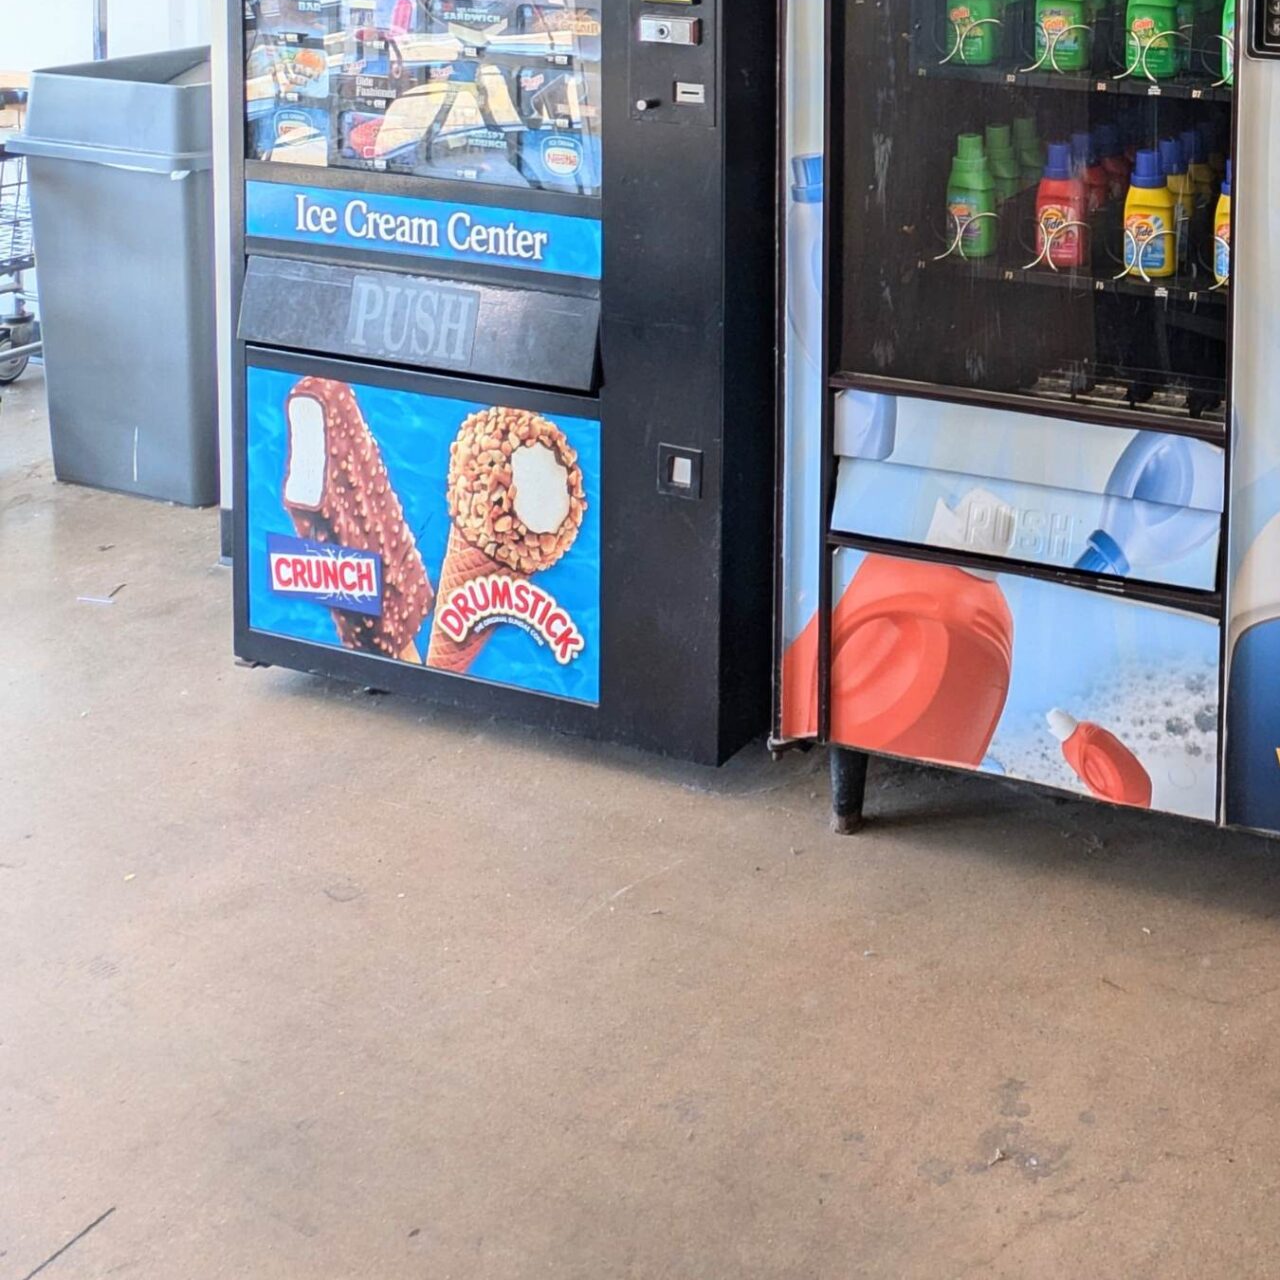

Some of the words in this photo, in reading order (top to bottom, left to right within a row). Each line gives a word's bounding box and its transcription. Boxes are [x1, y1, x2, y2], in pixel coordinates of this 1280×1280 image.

[443, 11, 500, 23] SANDWICH
[295, 194, 337, 233] Ice
[344, 199, 439, 248] Cream
[447, 211, 549, 260] Center
[351, 282, 474, 362] PUSH
[272, 555, 377, 593] CRUNCH
[440, 580, 579, 659] DRUMSTICK
